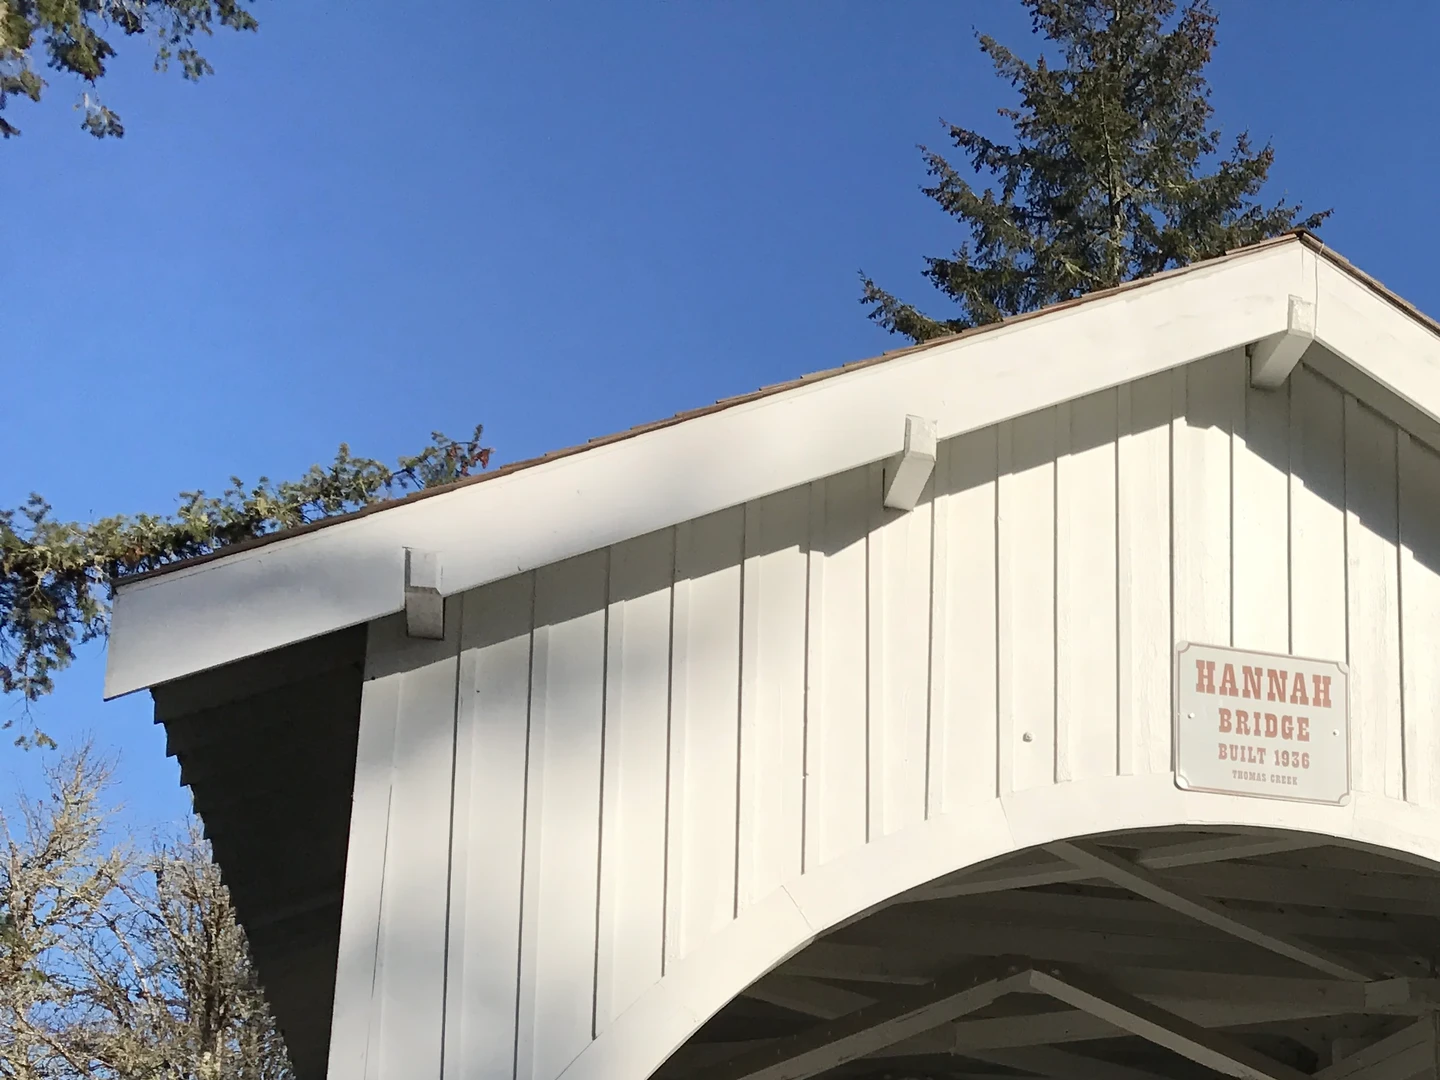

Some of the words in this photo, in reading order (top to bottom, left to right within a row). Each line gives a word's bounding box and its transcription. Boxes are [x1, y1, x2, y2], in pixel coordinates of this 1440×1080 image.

[1195, 659, 1332, 709] HANNAH
[1218, 707, 1310, 742] BRIDGE
[1218, 743, 1266, 765] BUILT
[1274, 749, 1310, 769] 1936
[1232, 769, 1267, 782] THOMAS
[1270, 774, 1298, 786] CREEK
